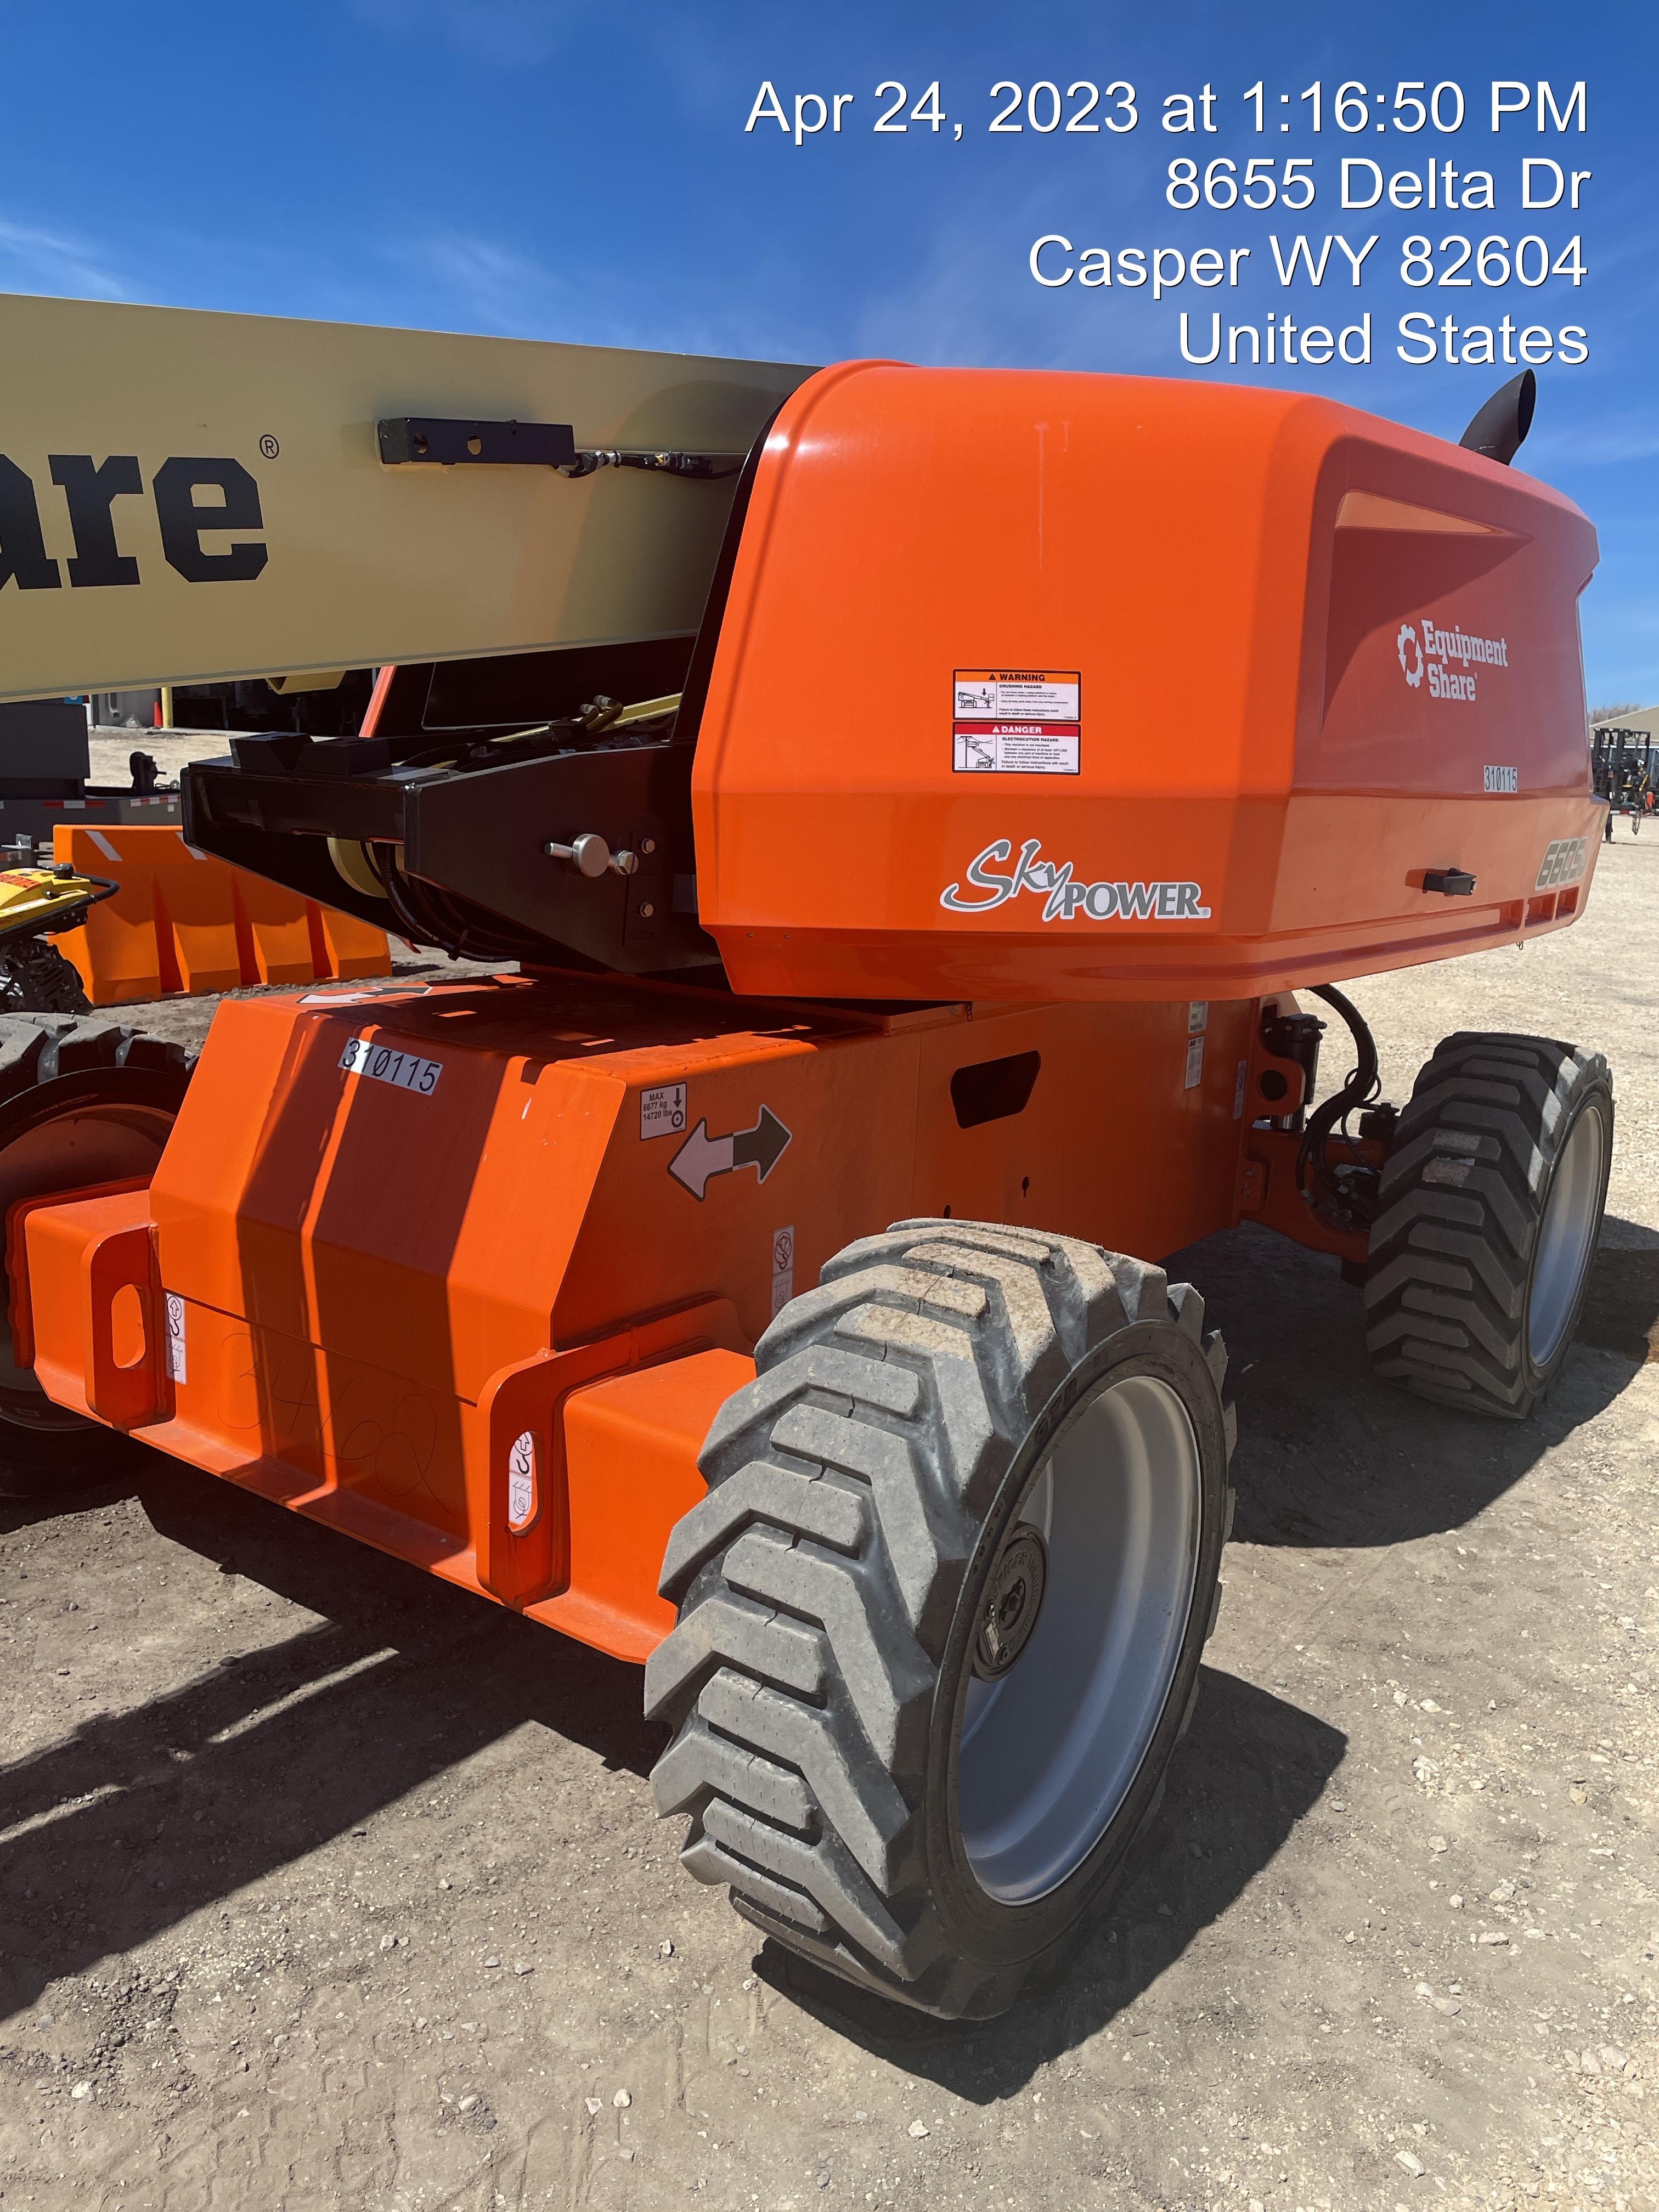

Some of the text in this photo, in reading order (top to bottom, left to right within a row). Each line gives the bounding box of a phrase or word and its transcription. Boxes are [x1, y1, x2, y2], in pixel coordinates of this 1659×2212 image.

[1421, 619, 1509, 668] Equipment
[999, 673, 1046, 681] WARNING
[1427, 663, 1476, 702] Share
[1001, 726, 1042, 734] DANGER
[1485, 766, 1517, 792] 310115
[342, 1040, 441, 1092] 310115
[649, 1091, 664, 1102] MAX
[643, 1101, 668, 1111] 6677 kg
[643, 1109, 673, 1121] 14720 lbs
